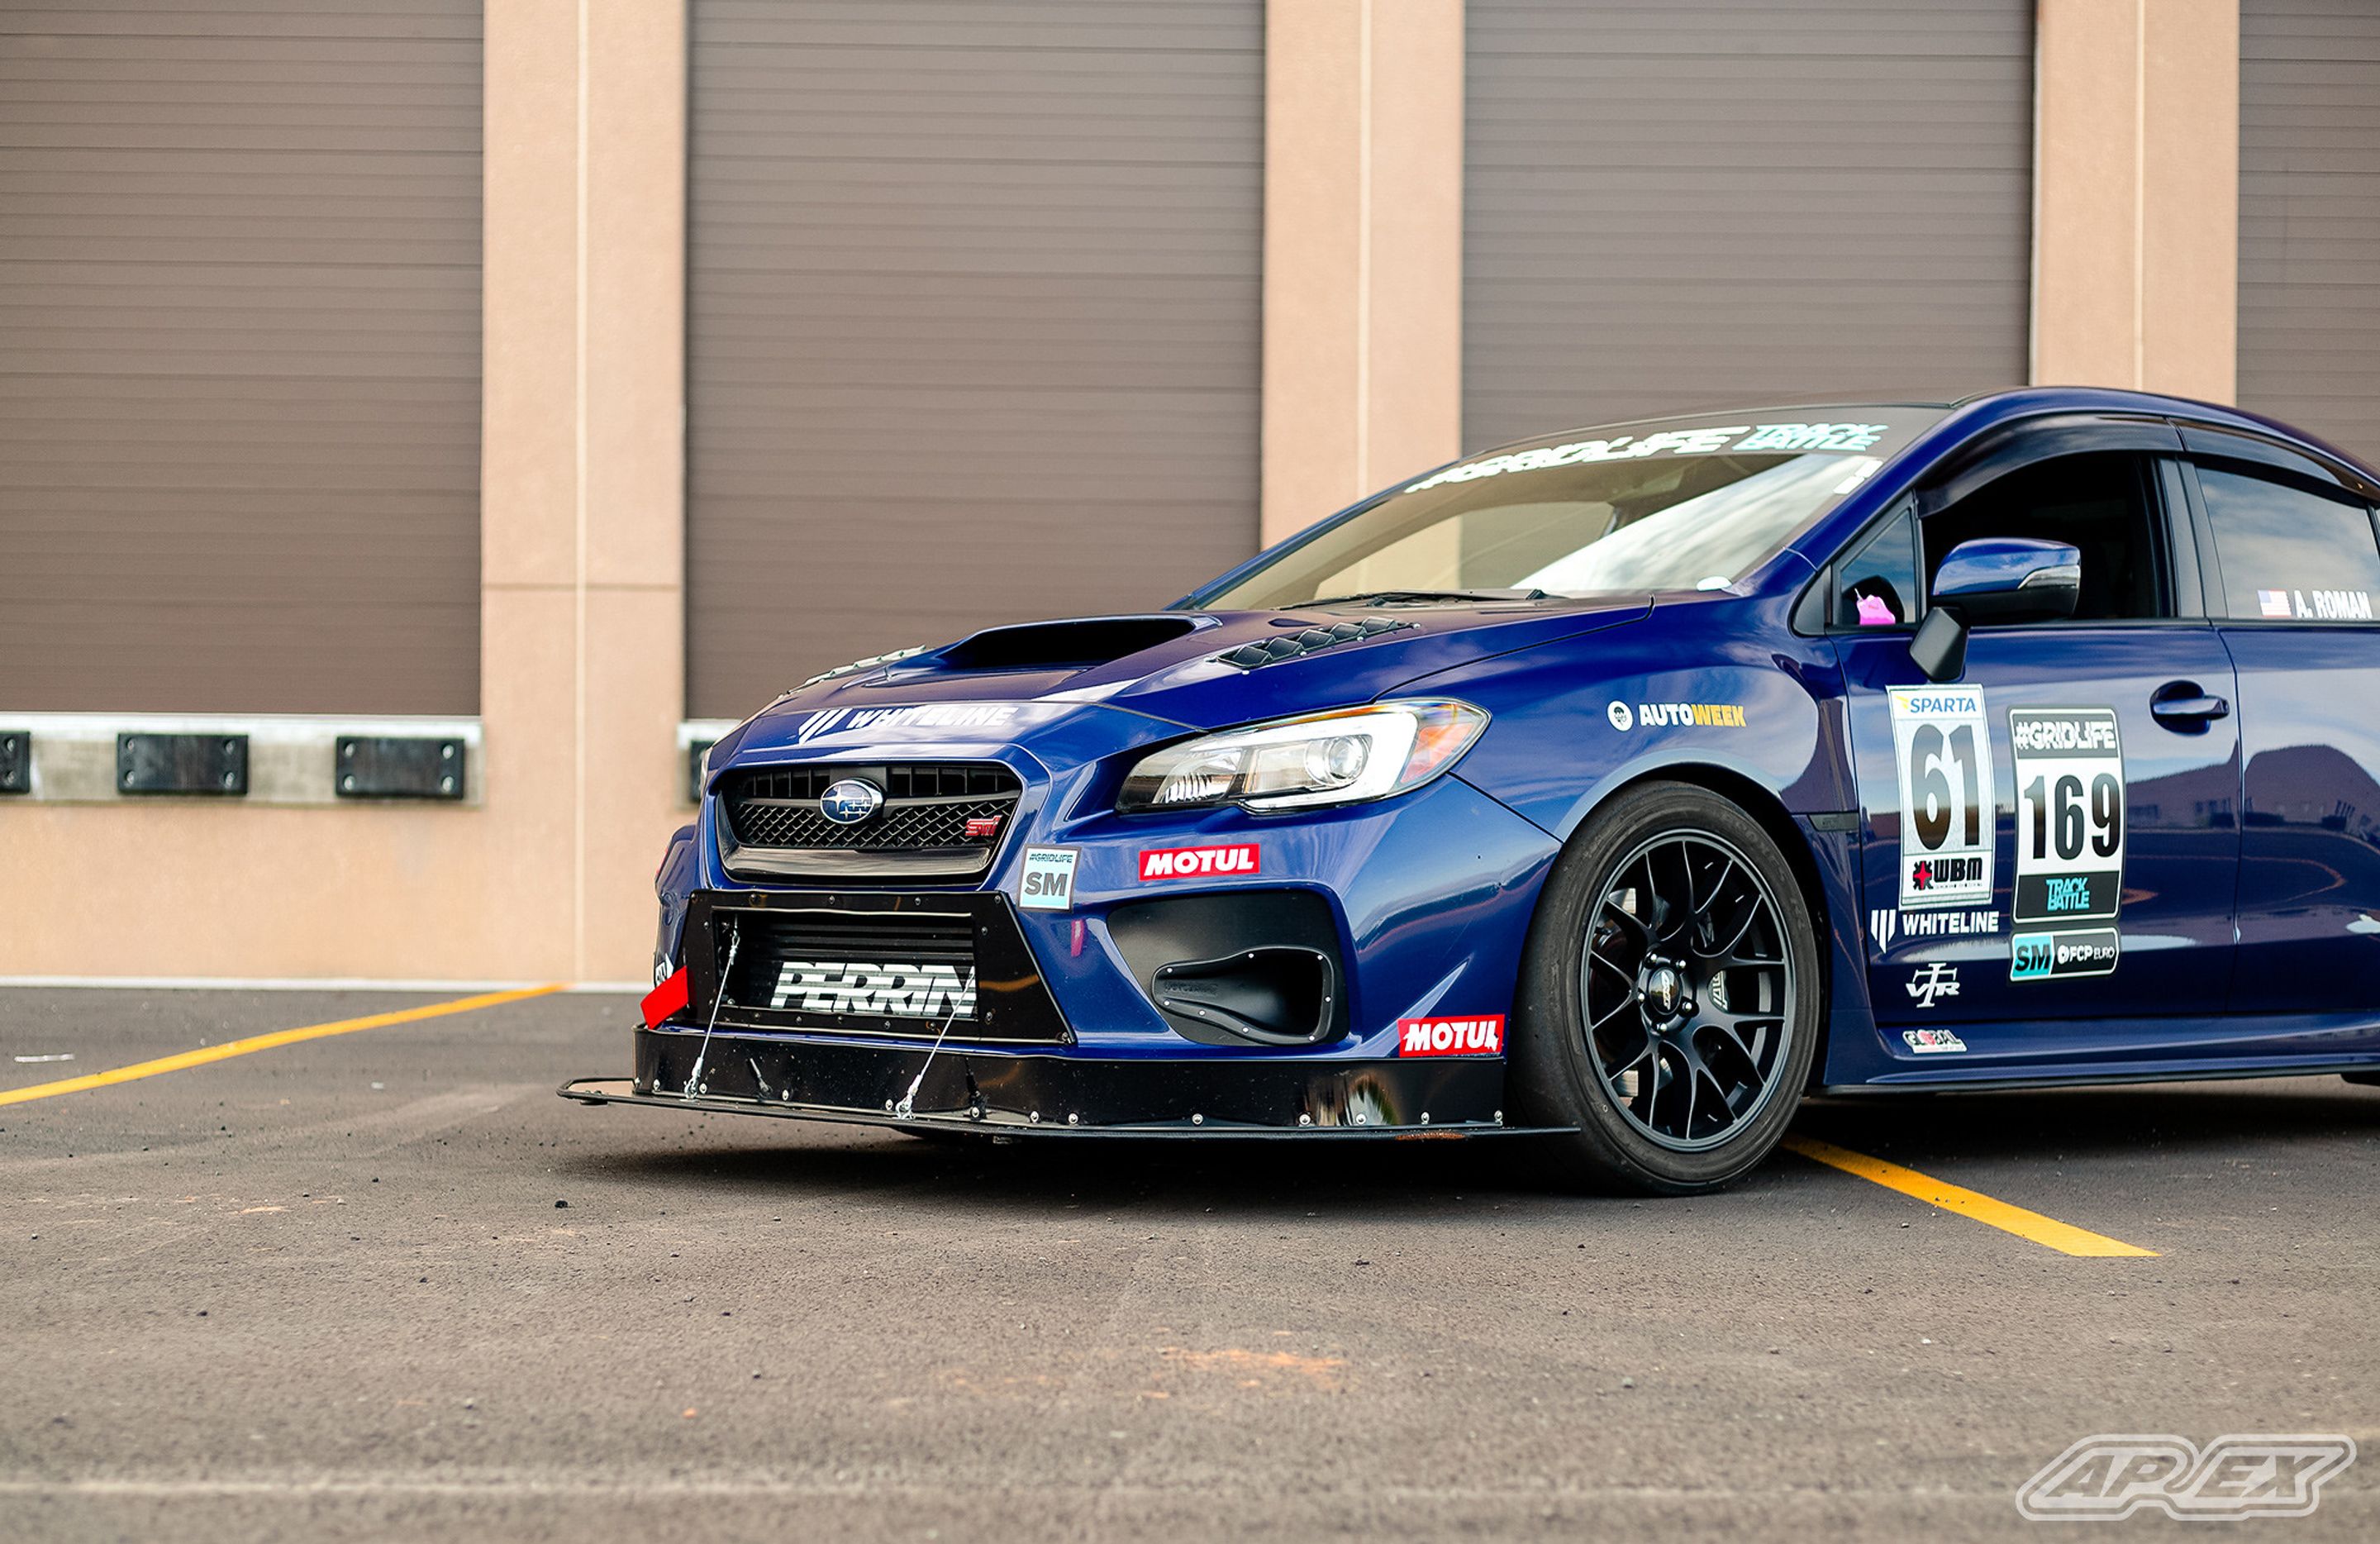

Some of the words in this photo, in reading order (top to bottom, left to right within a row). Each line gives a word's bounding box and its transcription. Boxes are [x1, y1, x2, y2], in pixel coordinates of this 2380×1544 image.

[2293, 589, 2314, 618] A.
[2312, 590, 2373, 619] ROMAN
[846, 706, 1019, 729] WHITELINE
[1639, 703, 1746, 727] AUTOWEEK
[1910, 698, 1977, 713] SPARTA
[2015, 721, 2116, 750] #GRIDLIFE
[1911, 724, 1983, 851] 61
[2024, 773, 2121, 860] 169
[1144, 847, 1254, 876] MOTUL
[1024, 871, 1069, 897] SM
[2045, 877, 2088, 894] TRACK
[2047, 891, 2090, 911] BATTLE
[1902, 910, 2000, 936] WHITELINE
[2015, 944, 2050, 972] SM
[2069, 945, 2094, 962] FCP
[769, 960, 978, 1019] PERRIN
[1402, 1020, 1500, 1052] MOTUL
